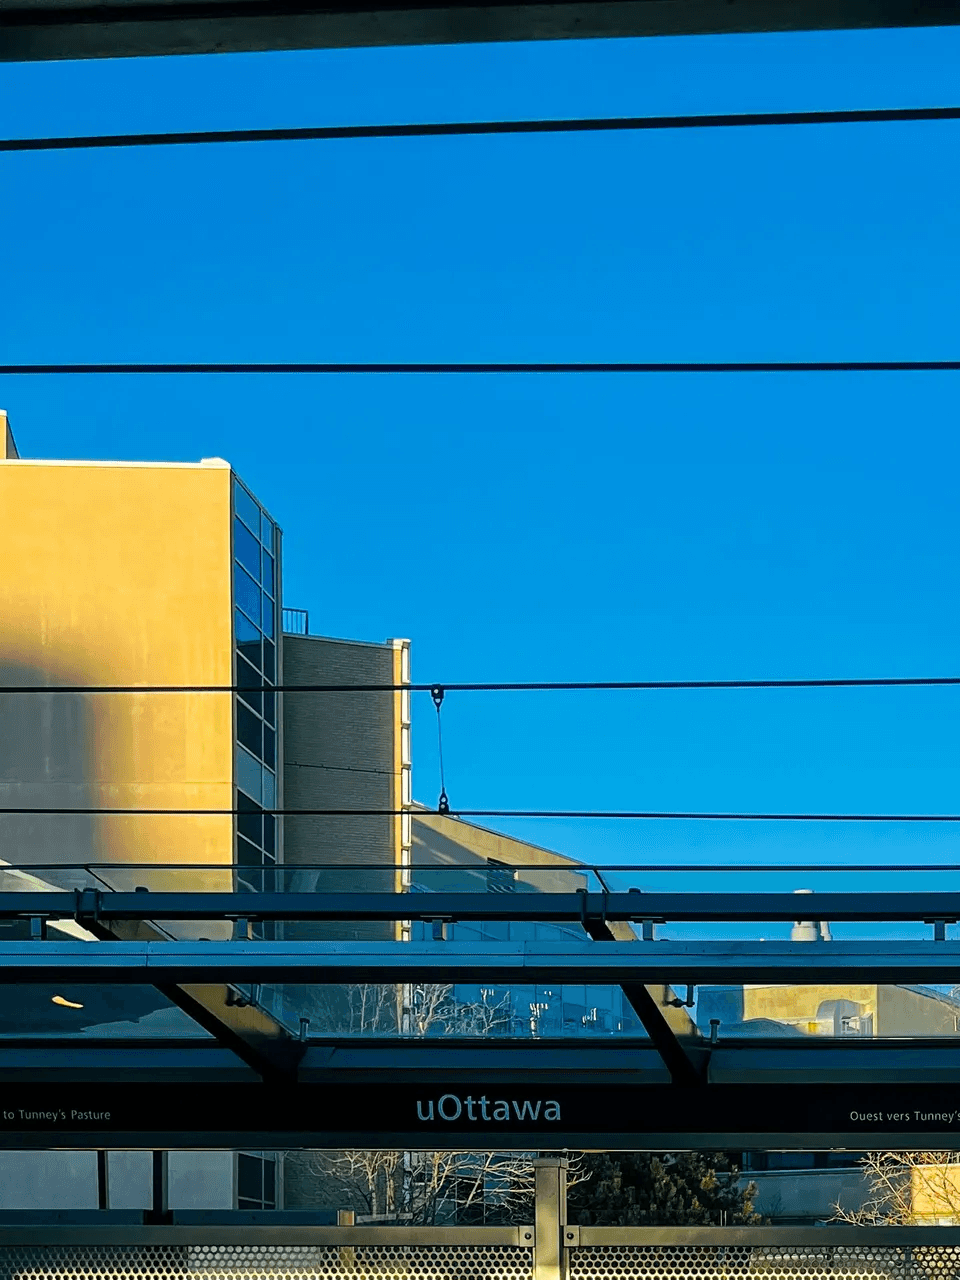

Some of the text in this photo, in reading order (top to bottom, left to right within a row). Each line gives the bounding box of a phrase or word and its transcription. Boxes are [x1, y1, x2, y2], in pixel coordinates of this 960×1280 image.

[416, 1094, 561, 1121] uOttawa
[3, 1109, 111, 1122] to Tunney's Pasture
[849, 1110, 884, 1122] Ouest
[886, 1112, 910, 1122] vers
